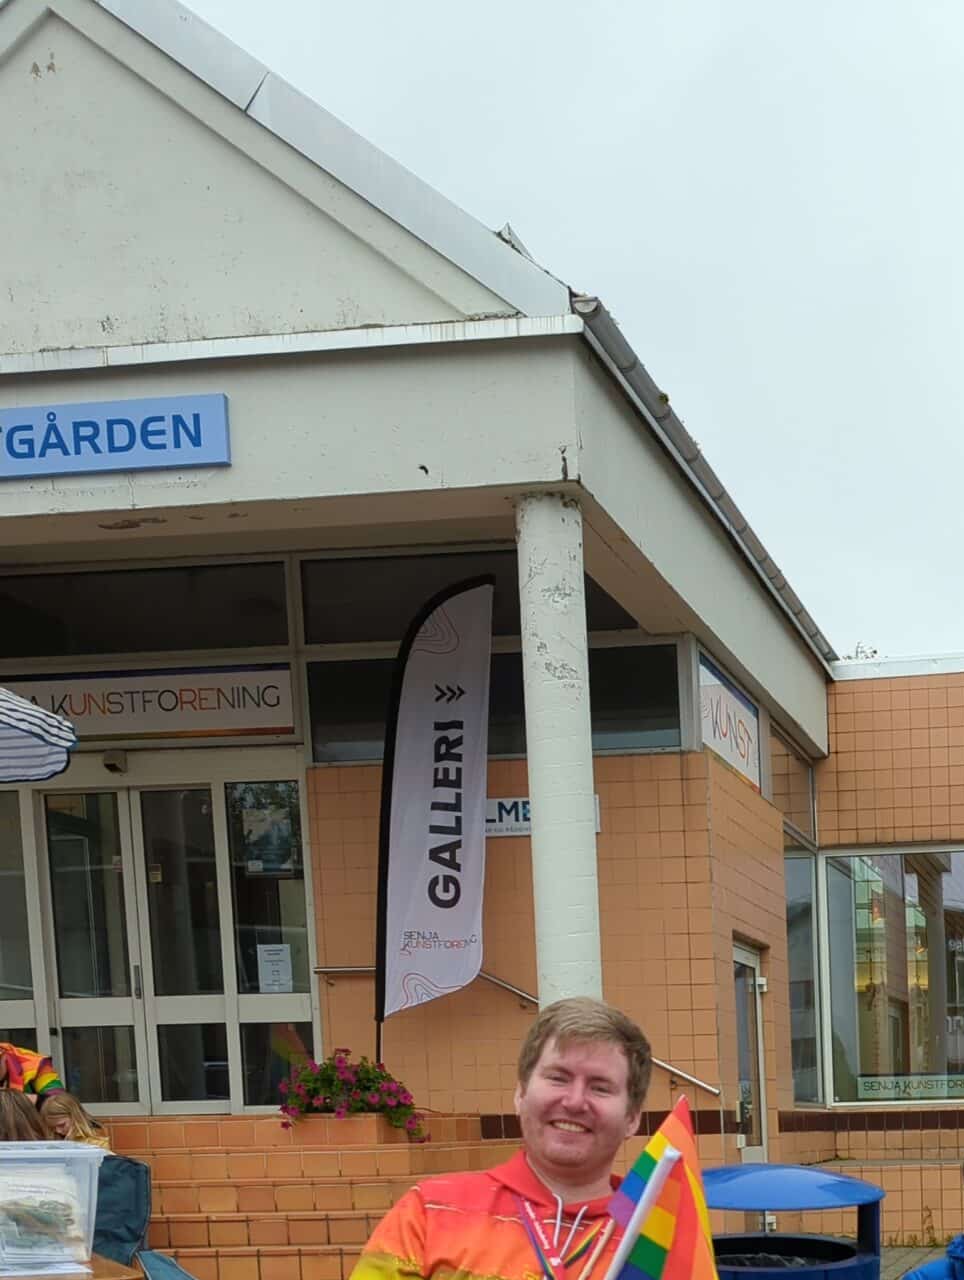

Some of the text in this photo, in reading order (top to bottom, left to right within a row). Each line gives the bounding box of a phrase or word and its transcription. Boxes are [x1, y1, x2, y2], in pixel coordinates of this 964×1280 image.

[0, 411, 202, 459] GÅRDEN
[52, 684, 281, 717] KUNSTFORENING
[710, 695, 753, 769] KUNST
[427, 720, 464, 909] GALLERI
[403, 930, 439, 940] SENJA
[863, 1080, 901, 1091] SENJA
